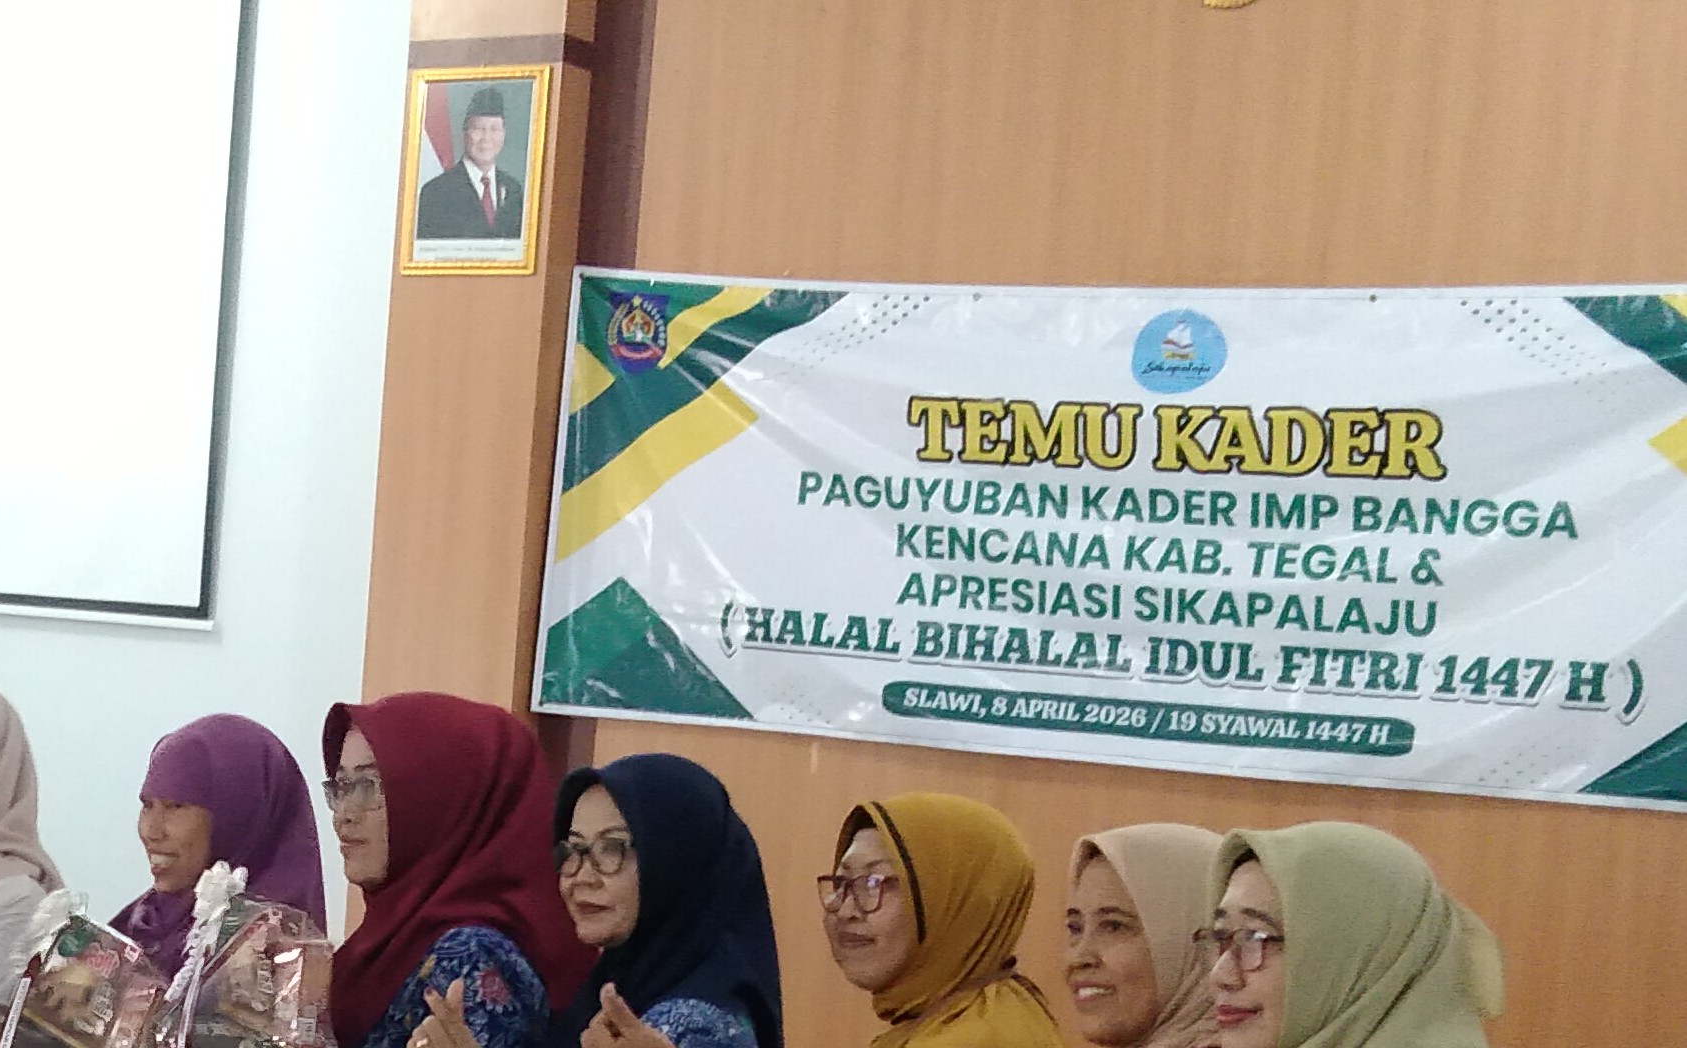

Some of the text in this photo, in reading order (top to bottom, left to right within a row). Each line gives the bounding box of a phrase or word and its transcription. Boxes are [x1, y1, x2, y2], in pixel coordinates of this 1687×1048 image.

[908, 395, 1447, 480] TEMU KADER
[797, 471, 1580, 540] PAGUYUBAN KADER IMP BANGGA
[895, 523, 1445, 587] KENCANA KAB. TEGAL &
[896, 572, 1438, 638] APRESIASI SIKAPALAJU
[743, 606, 902, 654] HALAL
[913, 620, 1133, 672] BIHALAL
[1145, 636, 1265, 684] IDUL
[1278, 644, 1426, 694] FITRI
[1434, 654, 1556, 699] 1447
[1564, 660, 1612, 704] H
[902, 687, 1391, 746] SLAWI, 8 APRIL 2026 / 19 SYAWAL 1447 H
